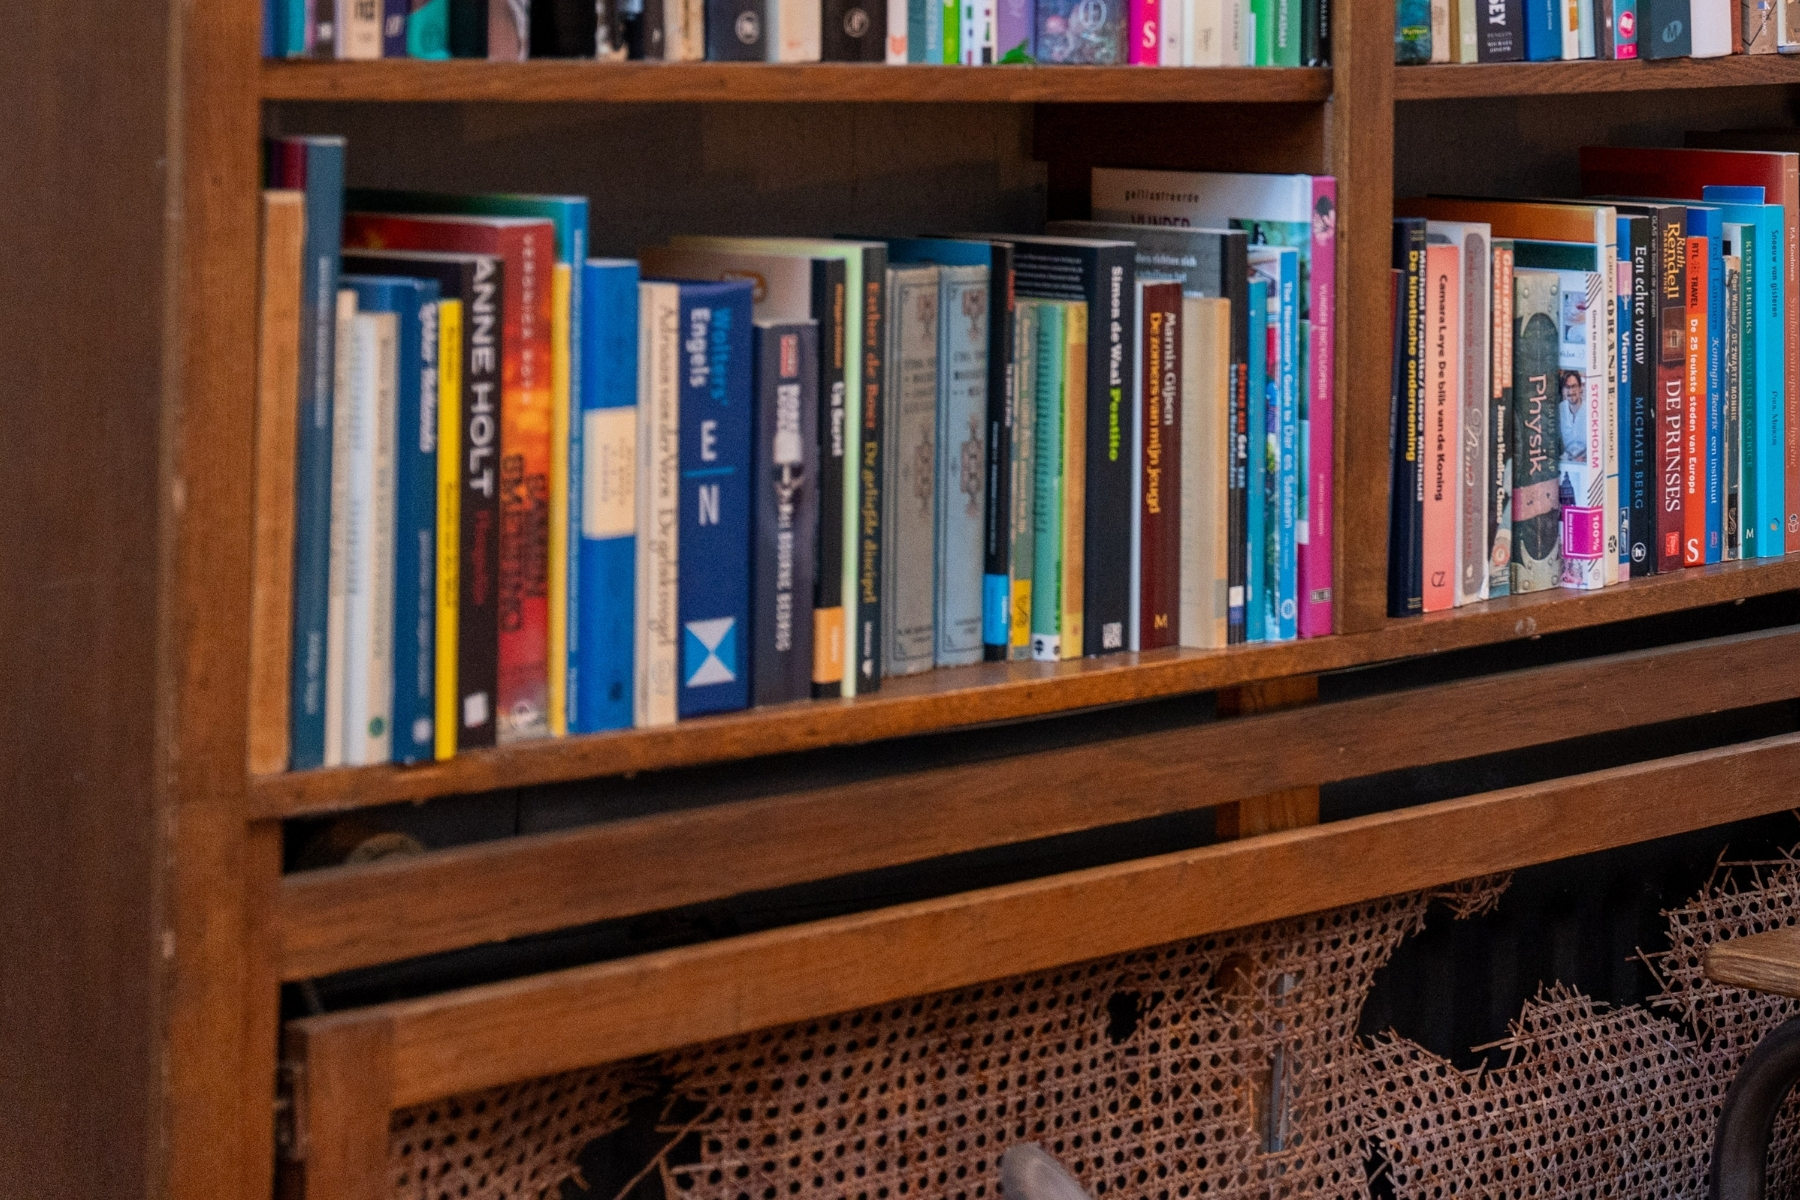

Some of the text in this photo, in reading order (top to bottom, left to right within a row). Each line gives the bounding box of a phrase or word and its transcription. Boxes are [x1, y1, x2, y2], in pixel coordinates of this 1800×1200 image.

[1666, 222, 1680, 300] Rendell
[1676, 237, 1685, 269] Ruth
[470, 258, 494, 497] ANNE HOLT
[686, 308, 710, 387] Engels
[1108, 266, 1124, 461] Simon de Waal Pentito
[1162, 312, 1177, 425] Marnix Gijsen
[1433, 275, 1448, 501] Camara Laye De blik van de Koning
[1620, 331, 1630, 384] Vienna
[1634, 246, 1647, 509] Een echte vrouw MICHAEL BERG
[1686, 242, 1699, 494] RTL TRAVEL De 25 leukste steden van Europa
[1146, 313, 1162, 514] De zomers van mijn jeugd
[1524, 374, 1547, 476] Physik
[1591, 383, 1600, 469] STOCKHOLM
[1664, 380, 1681, 512] DE PRINSES
[1591, 514, 1601, 551] 100%
